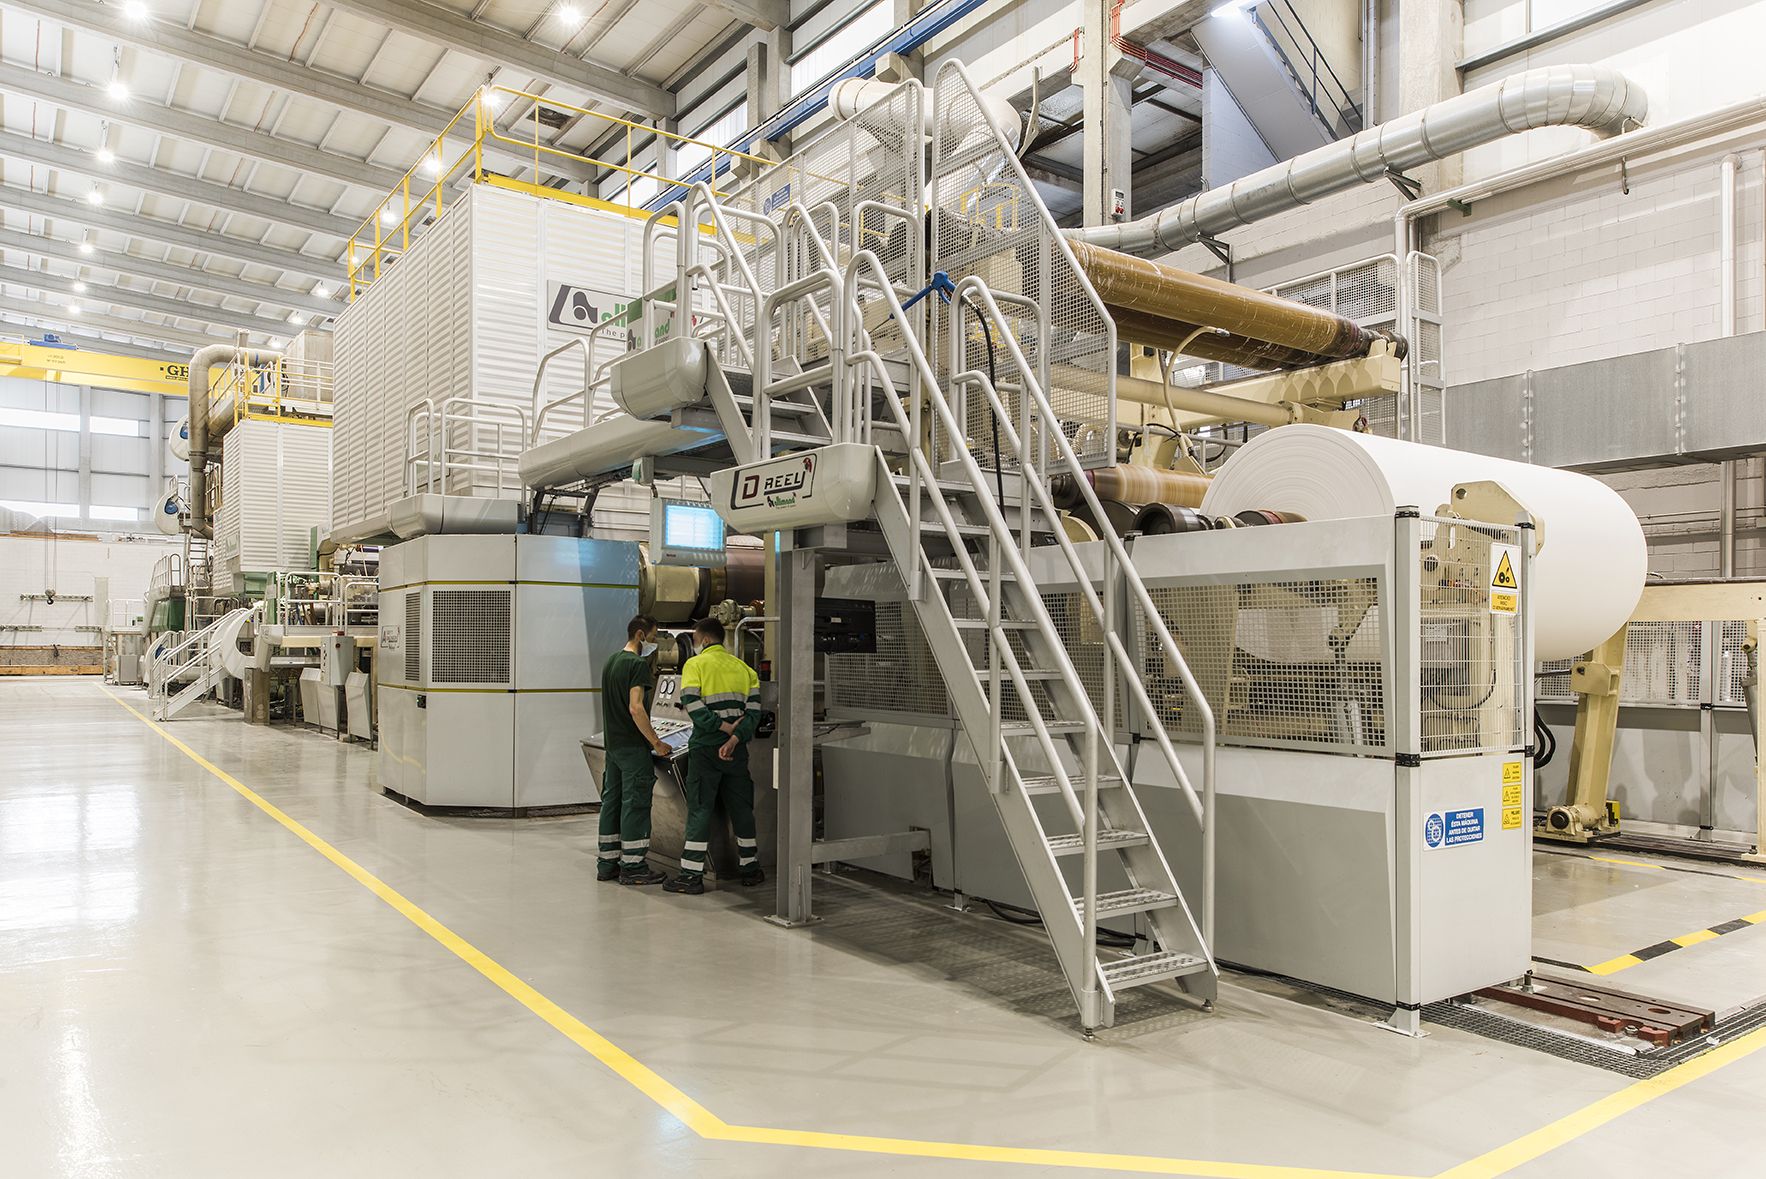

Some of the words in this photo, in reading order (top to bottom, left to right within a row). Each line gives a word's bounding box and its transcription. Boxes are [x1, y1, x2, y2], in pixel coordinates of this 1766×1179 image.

[742, 475, 760, 499] D
[764, 472, 801, 489] REEL
[1456, 811, 1473, 819] DETENER
